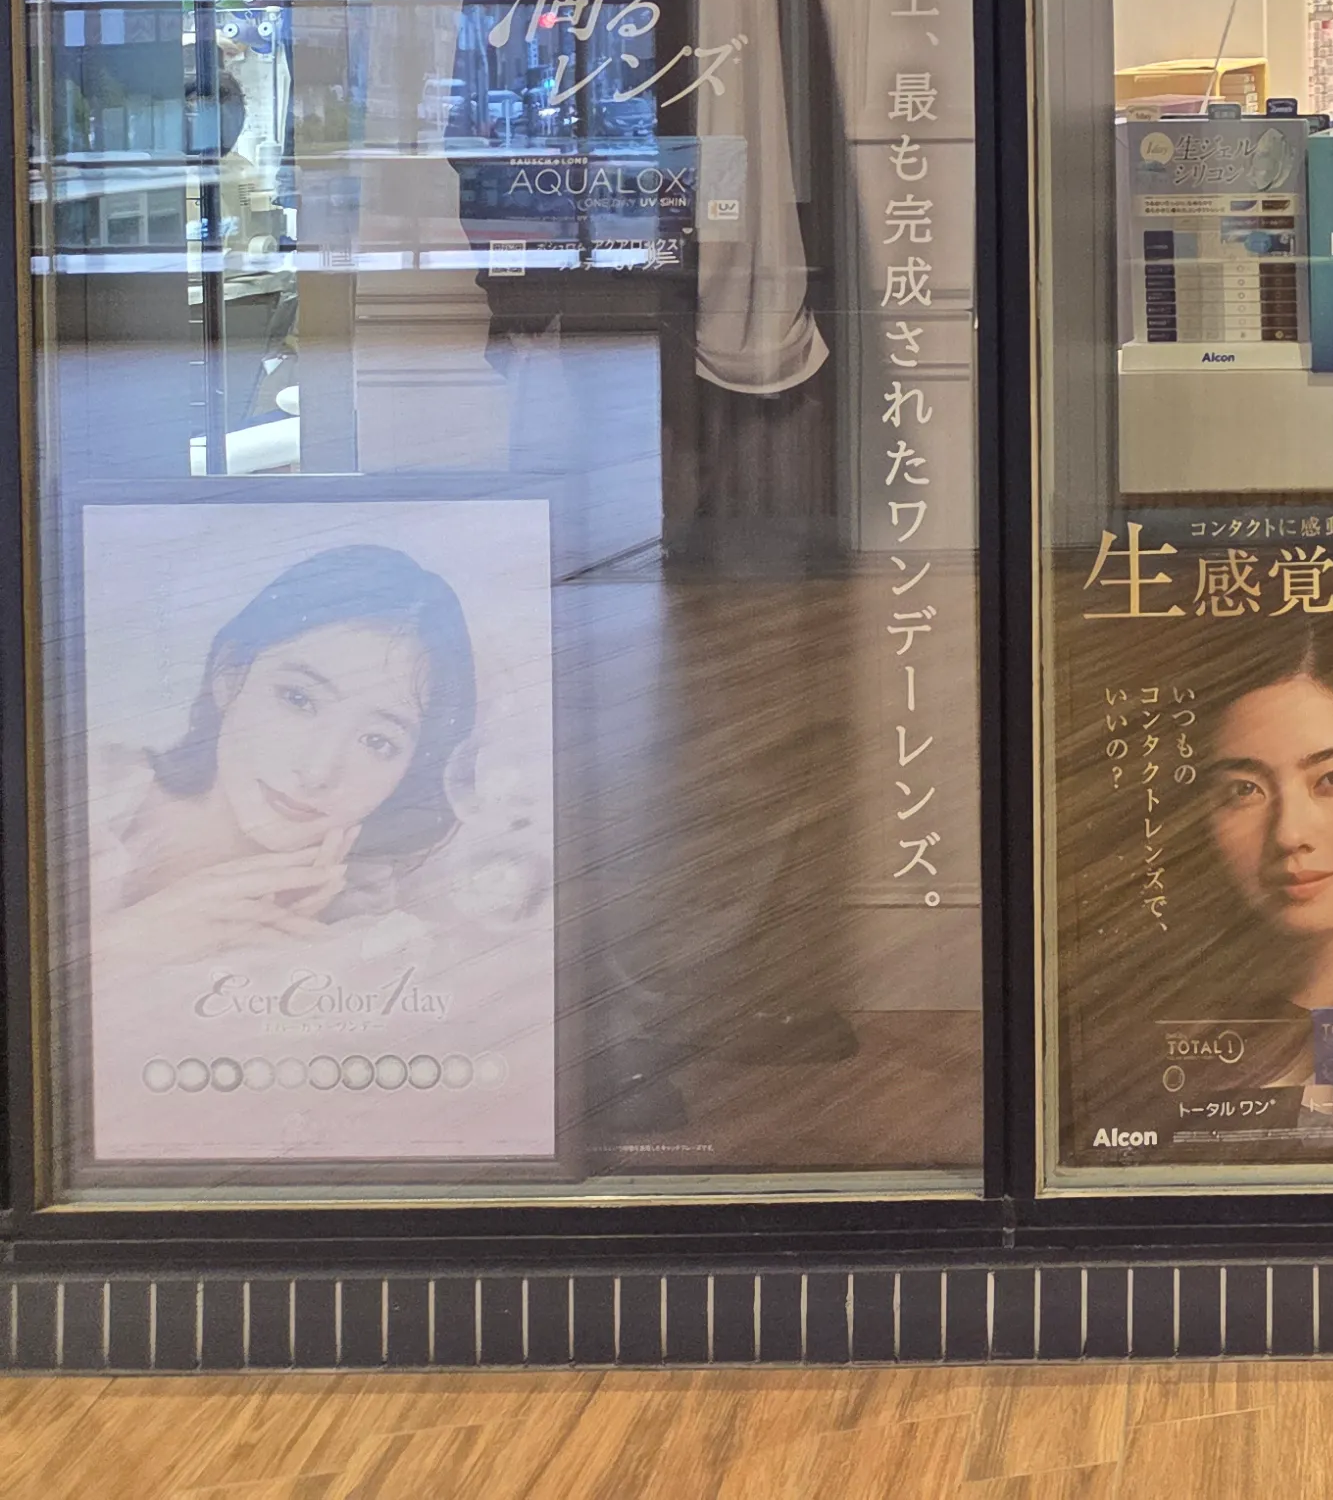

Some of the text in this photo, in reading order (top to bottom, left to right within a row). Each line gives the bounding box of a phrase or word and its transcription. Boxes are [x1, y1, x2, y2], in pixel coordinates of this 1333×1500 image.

[549, 33, 750, 108] レンズ
[508, 168, 687, 196] AQUALOX
[1174, 165, 1245, 188] シリコン
[1202, 352, 1235, 363] Alcon
[1105, 686, 1129, 789] いいの?
[1171, 685, 1197, 785] いつもの
[1140, 687, 1168, 931] コンタクトレンズで、
[1166, 1039, 1223, 1057] TOTAL
[1179, 1101, 1234, 1118] トータル
[1093, 1127, 1158, 1148] Alcon
